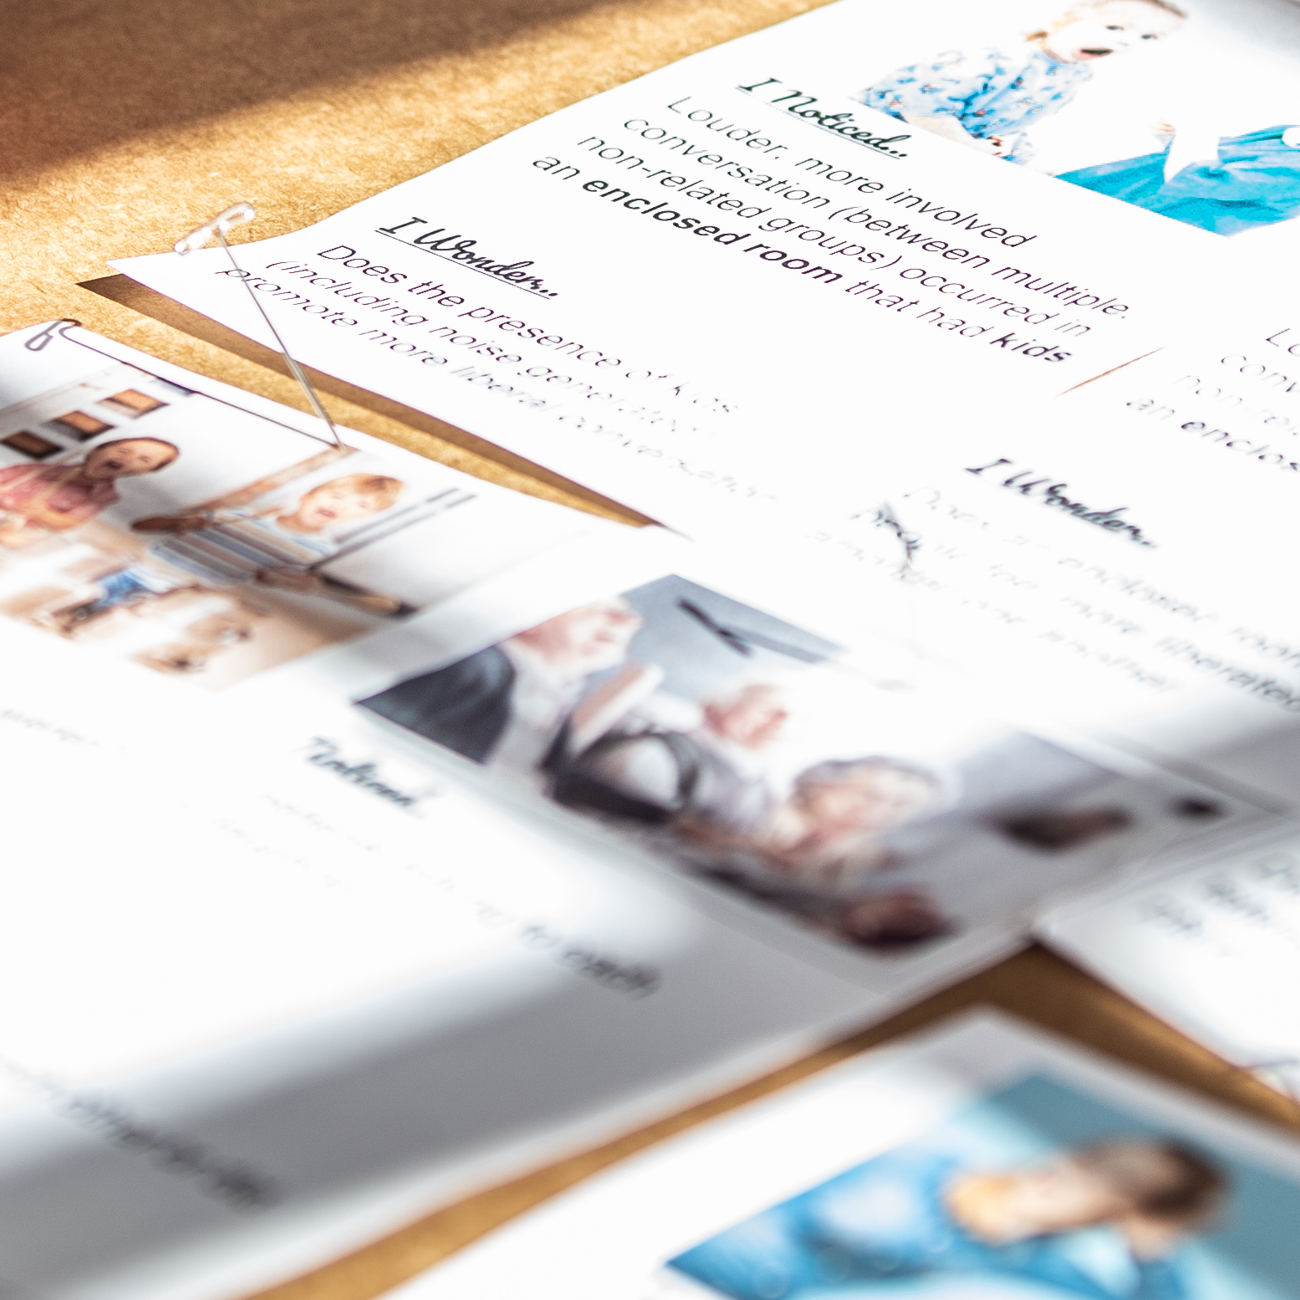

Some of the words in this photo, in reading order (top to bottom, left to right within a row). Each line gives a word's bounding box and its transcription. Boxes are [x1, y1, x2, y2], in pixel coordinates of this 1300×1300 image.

[379, 216, 428, 235] I
[577, 135, 772, 219] non-related
[758, 216, 903, 272] groups)
[899, 266, 1059, 326] occurred
[1054, 317, 1091, 337] in
[624, 118, 831, 210] conversation
[827, 205, 991, 269] (between
[668, 96, 789, 161] Louder,
[794, 155, 884, 194] more
[884, 187, 1037, 248] involved
[214, 266, 358, 329] promote
[358, 328, 448, 367] more
[265, 260, 430, 327] (including
[429, 324, 523, 366] noise
[316, 244, 408, 285] Does
[407, 280, 465, 308] the
[457, 305, 622, 369] presence
[532, 156, 581, 181] an
[582, 179, 752, 246] enclosed
[742, 242, 843, 284] room
[844, 279, 919, 313] that
[915, 305, 996, 339] had
[989, 331, 1072, 364] kids
